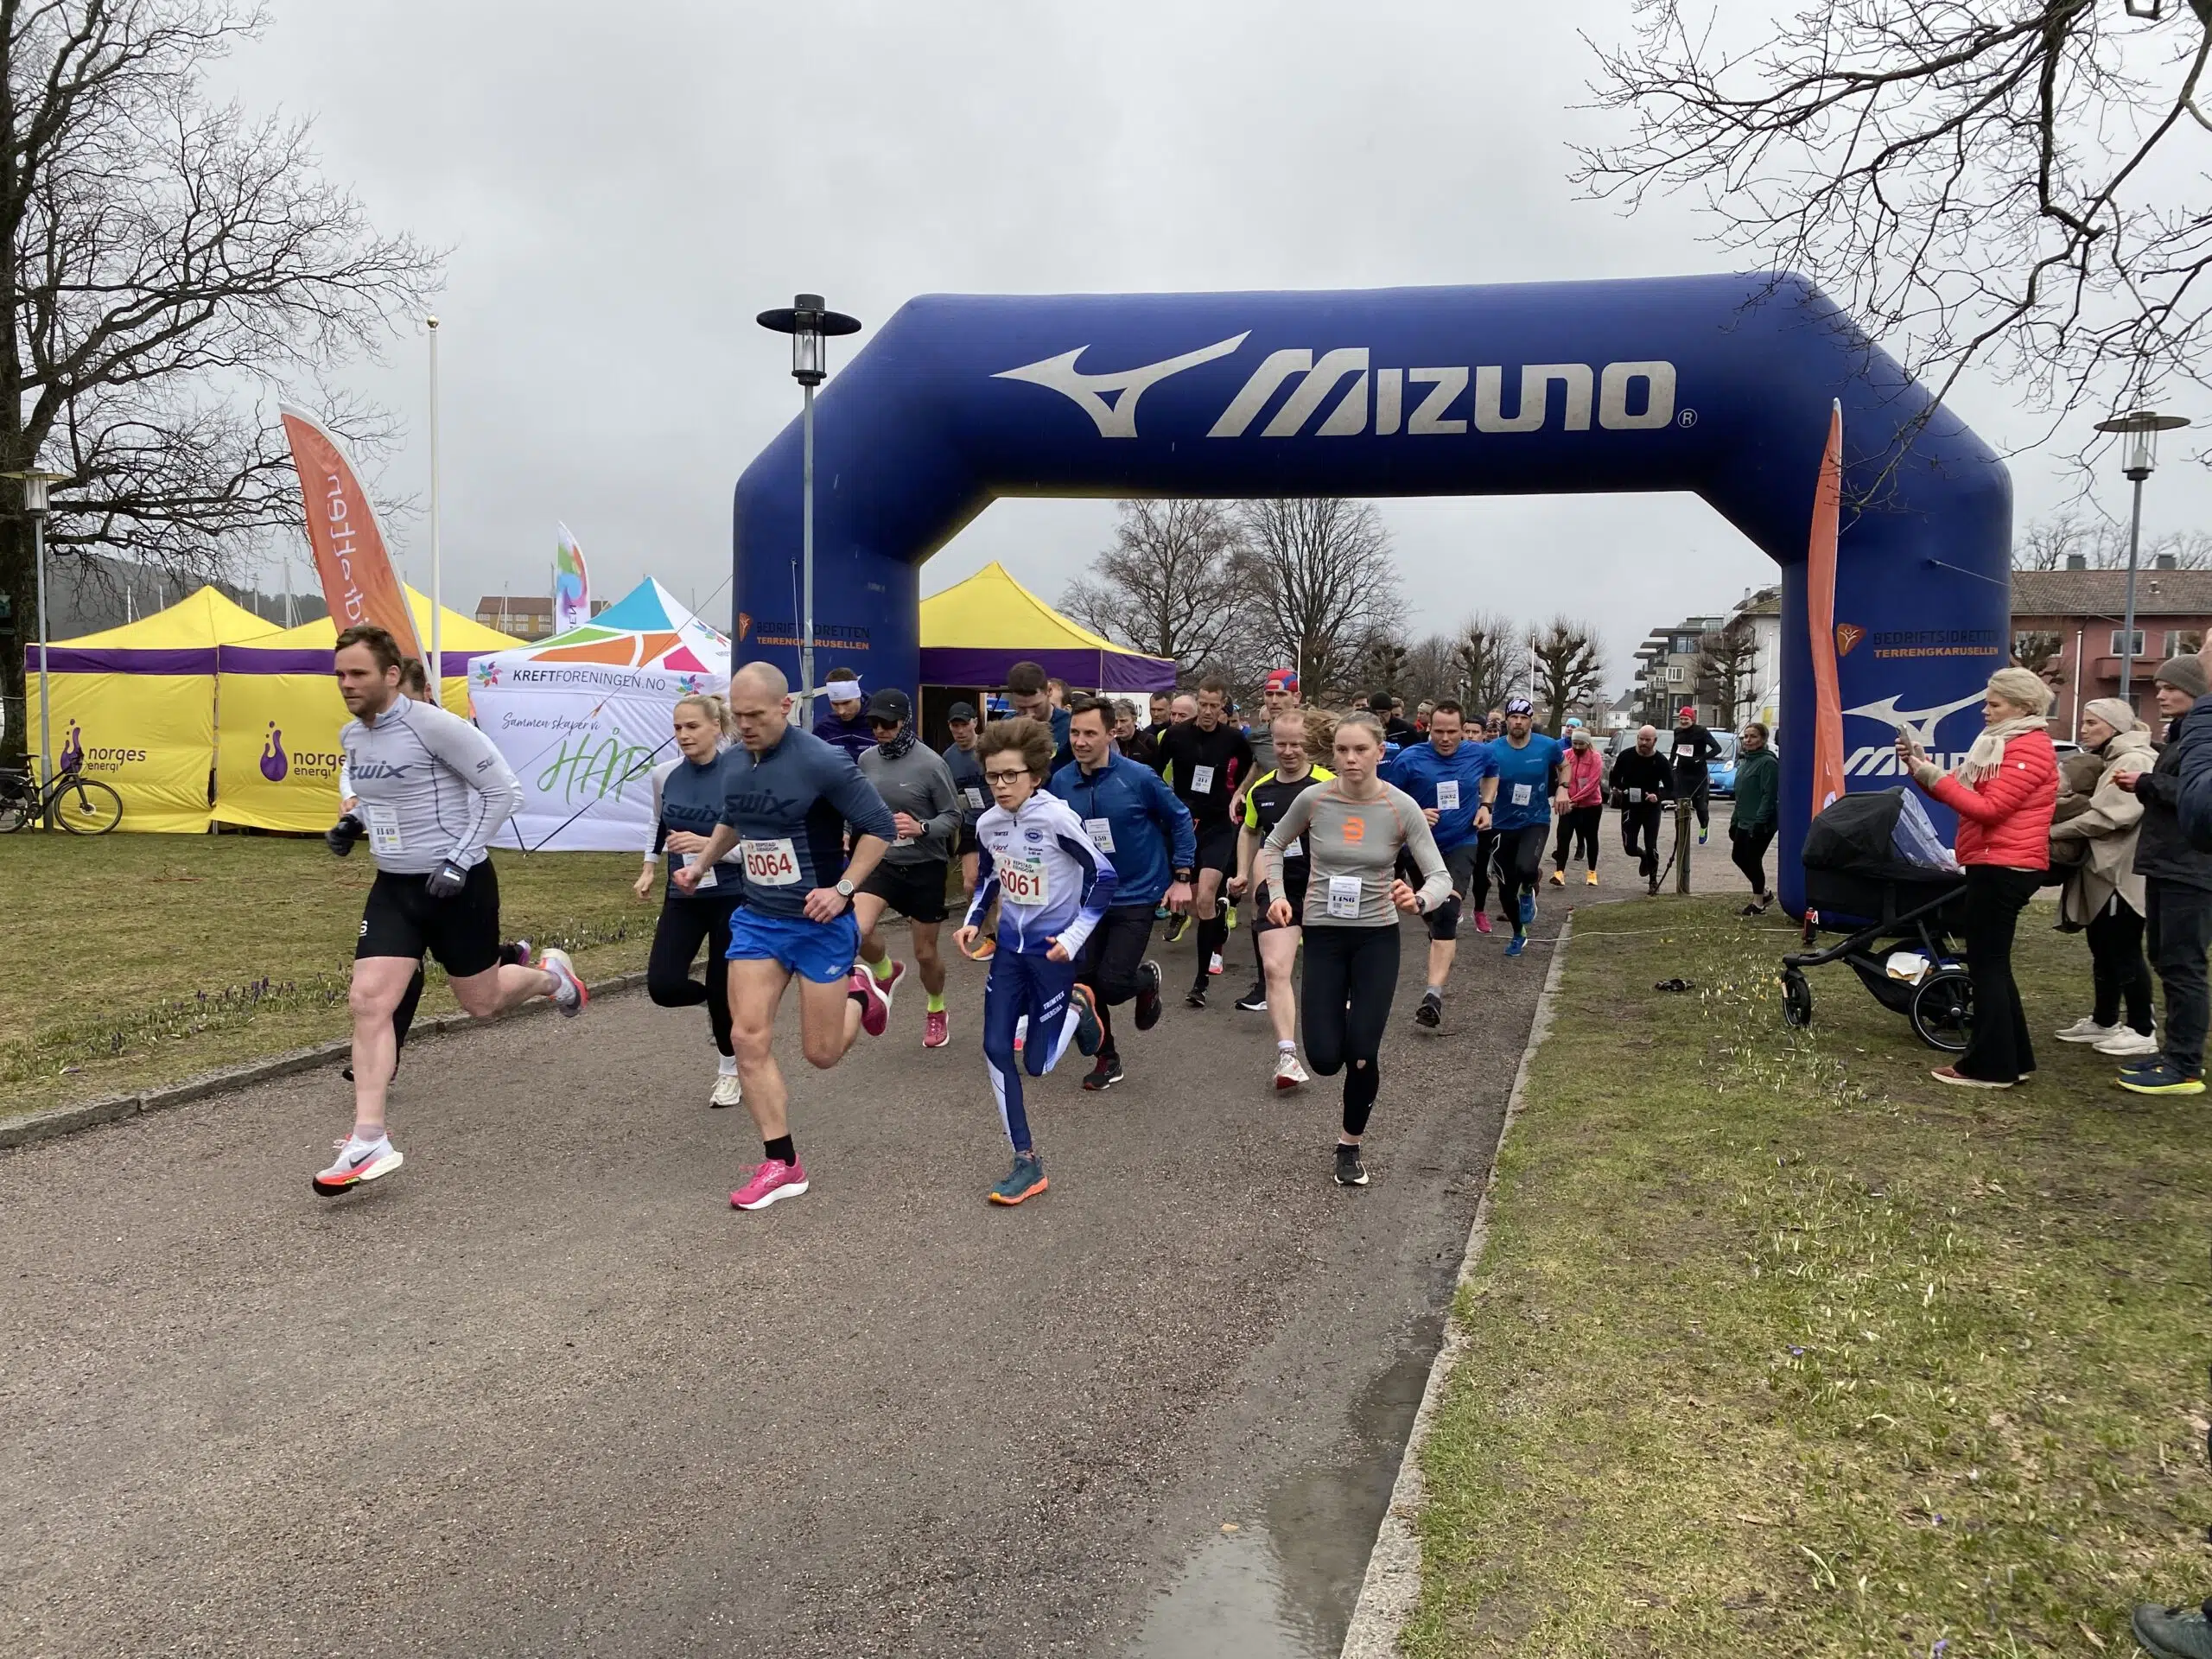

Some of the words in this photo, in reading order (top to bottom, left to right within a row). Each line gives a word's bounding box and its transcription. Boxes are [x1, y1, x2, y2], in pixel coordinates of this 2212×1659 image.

[1206, 347, 1677, 438] MIZUNO
[1873, 646, 1999, 658] TERRENGKARUSELLEN
[512, 670, 666, 691] KREFTFORENINGEN.NO
[502, 711, 550, 730] Sammen
[551, 714, 589, 736] skaper
[590, 719, 601, 730] vi
[87, 761, 119, 774] energi
[88, 748, 147, 766] norges
[293, 752, 346, 772] norge
[537, 727, 658, 805] HÅP
[294, 766, 331, 779] energi
[747, 853, 792, 877] 6064
[1000, 868, 1039, 896] 6061
